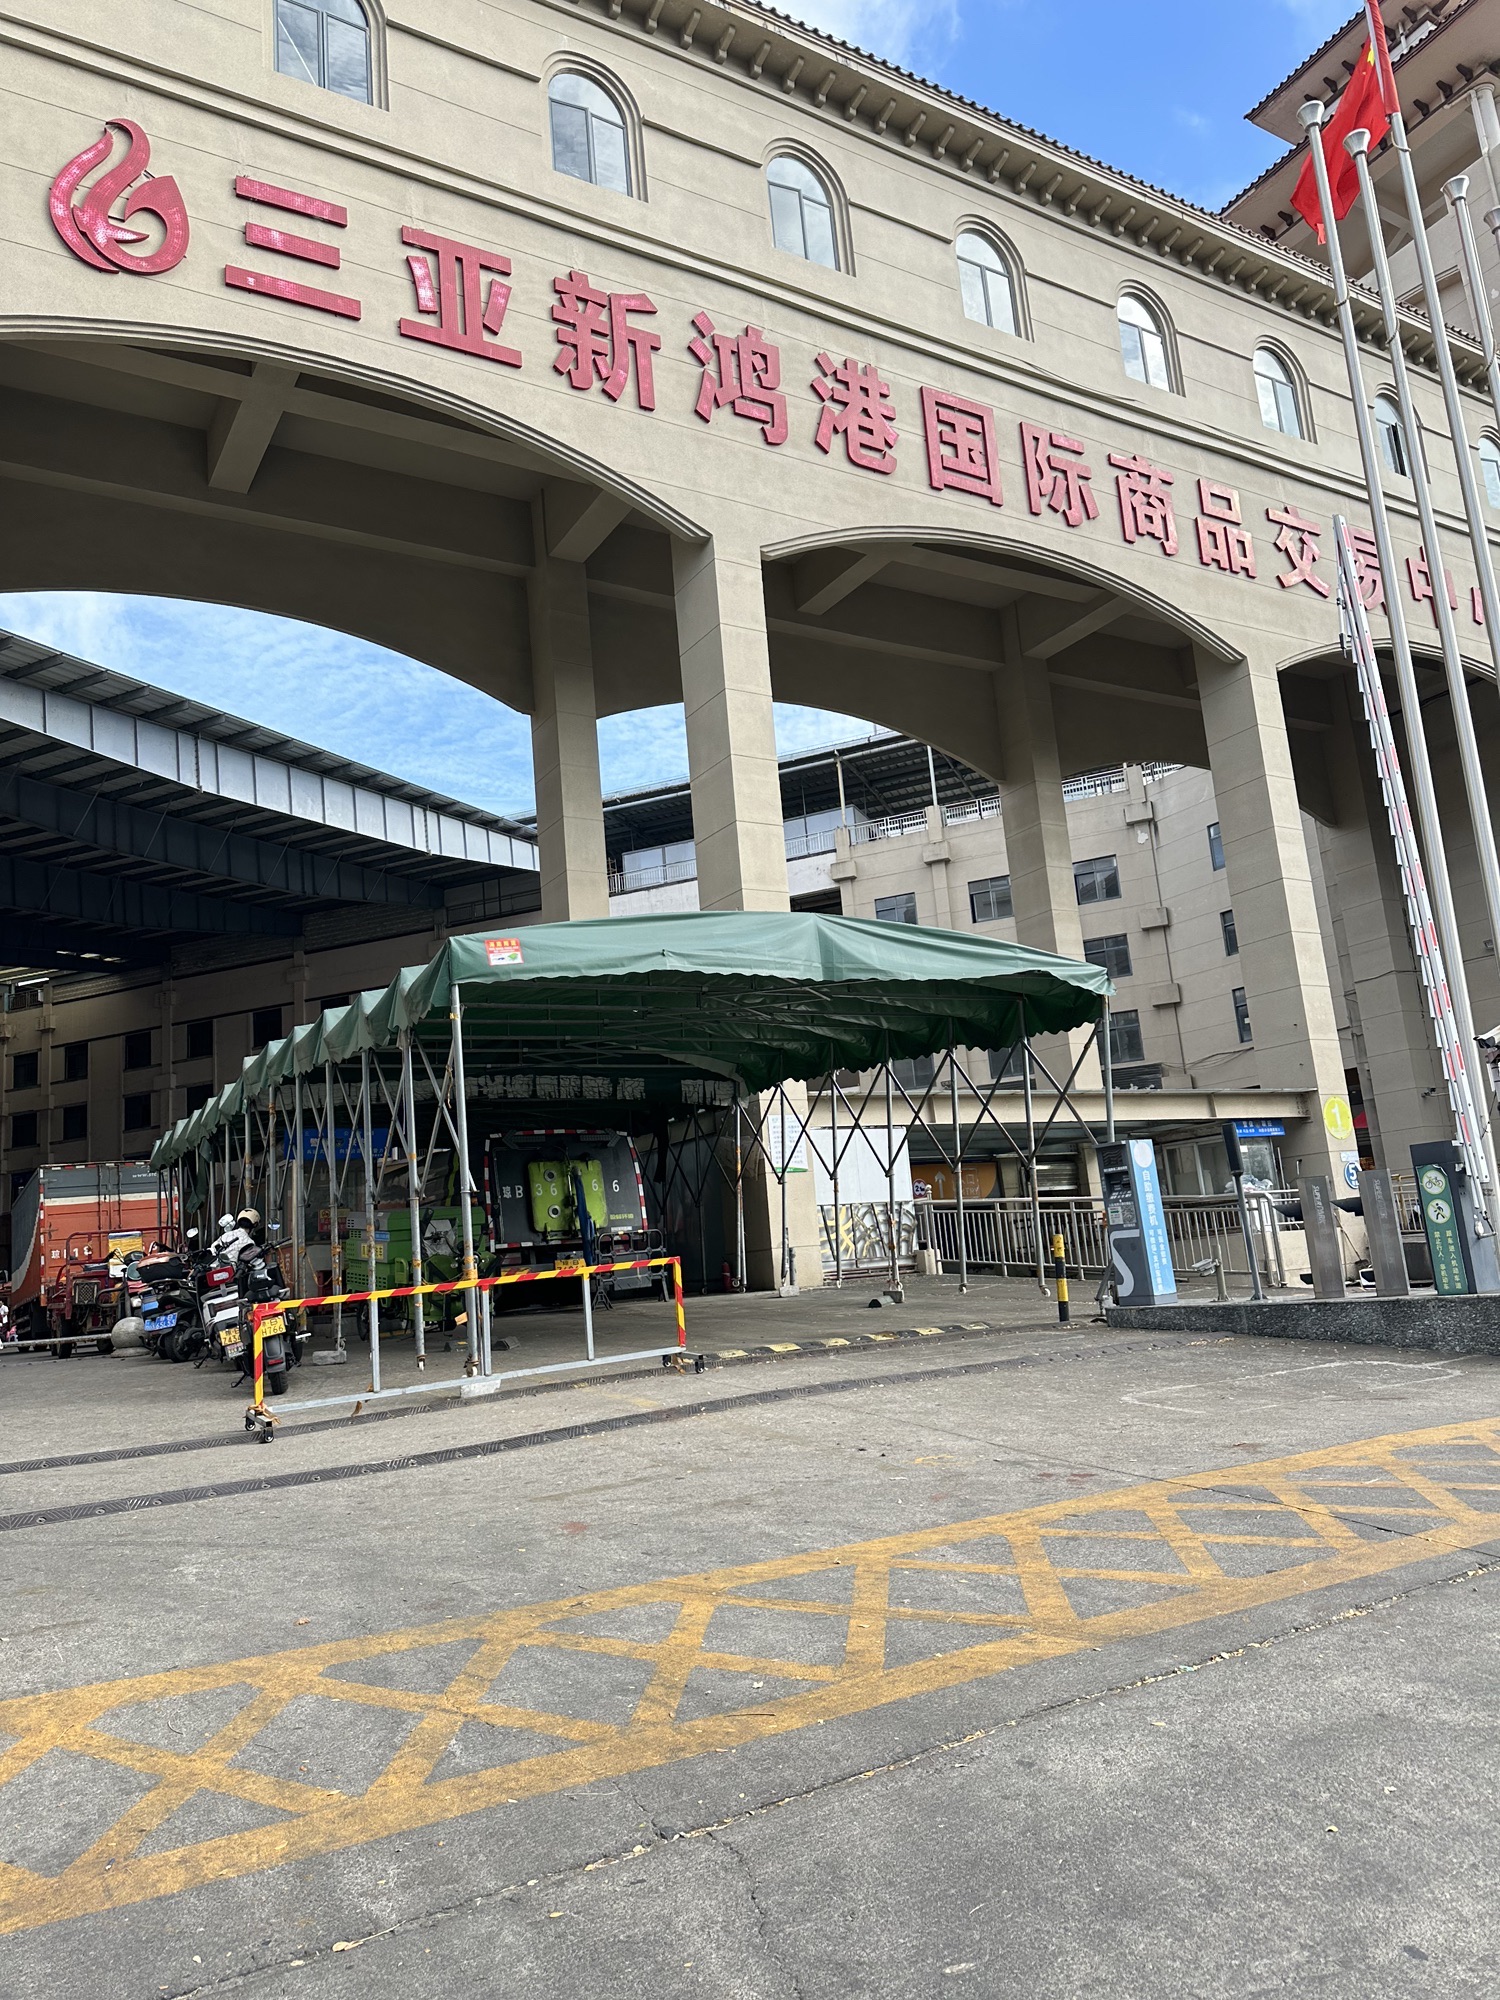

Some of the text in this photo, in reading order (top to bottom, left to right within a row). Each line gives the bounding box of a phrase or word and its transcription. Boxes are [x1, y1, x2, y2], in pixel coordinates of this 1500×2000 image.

[224, 175, 1484, 627] 三亚新鸿港国际商品交易中
